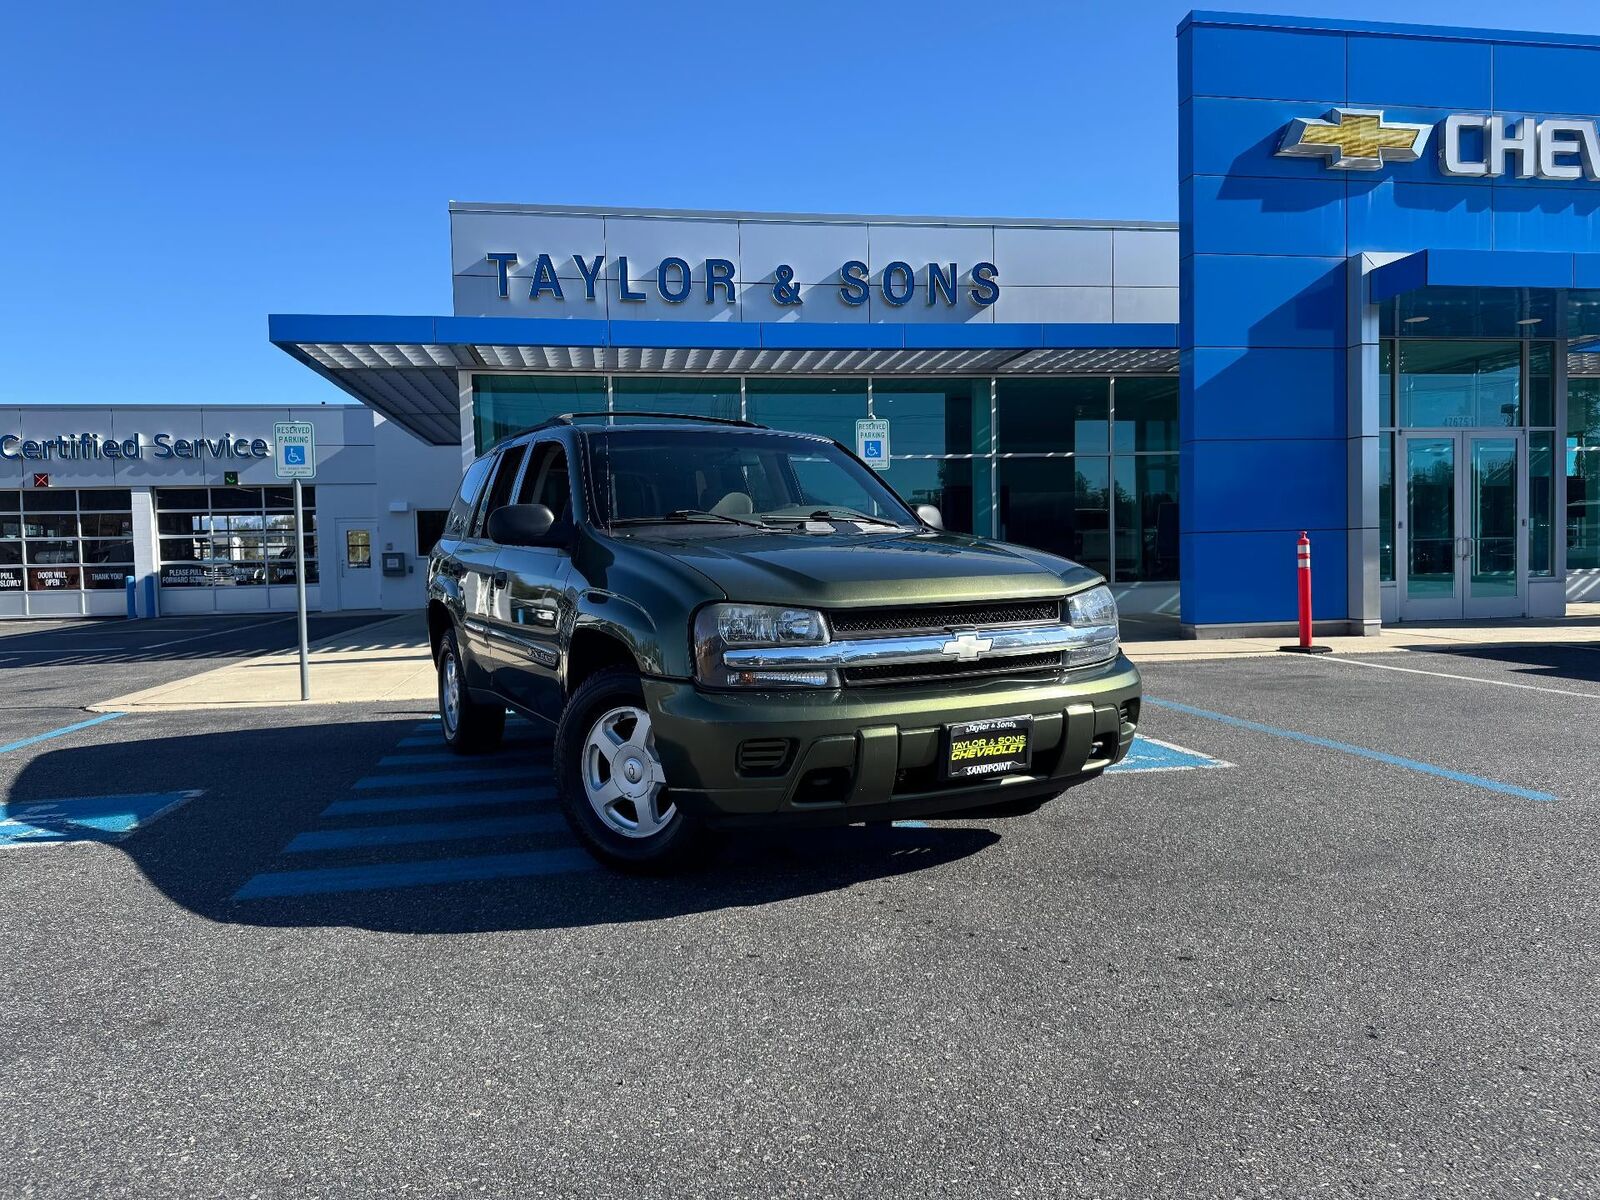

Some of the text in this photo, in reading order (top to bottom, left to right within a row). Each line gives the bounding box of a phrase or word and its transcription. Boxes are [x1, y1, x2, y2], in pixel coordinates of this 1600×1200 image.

[485, 252, 1000, 306] TAYLOR & SONS
[276, 426, 310, 434] RESERVED
[860, 431, 885, 439] PARKING
[278, 436, 309, 444] PARKING
[0, 433, 271, 460] Certified Service
[0, 572, 14, 580] PULL
[37, 571, 67, 579] DOOR WILL
[91, 573, 110, 581] THANK
[169, 569, 189, 577] PLEASE
[0, 580, 21, 588] SLOWLY
[45, 579, 60, 587] OPEN
[968, 723, 990, 733] Taylor
[952, 735, 1026, 750] TAYLOR & SONS
[951, 744, 1025, 761] CHEVROLET
[967, 762, 1011, 775] SANDPOINT
